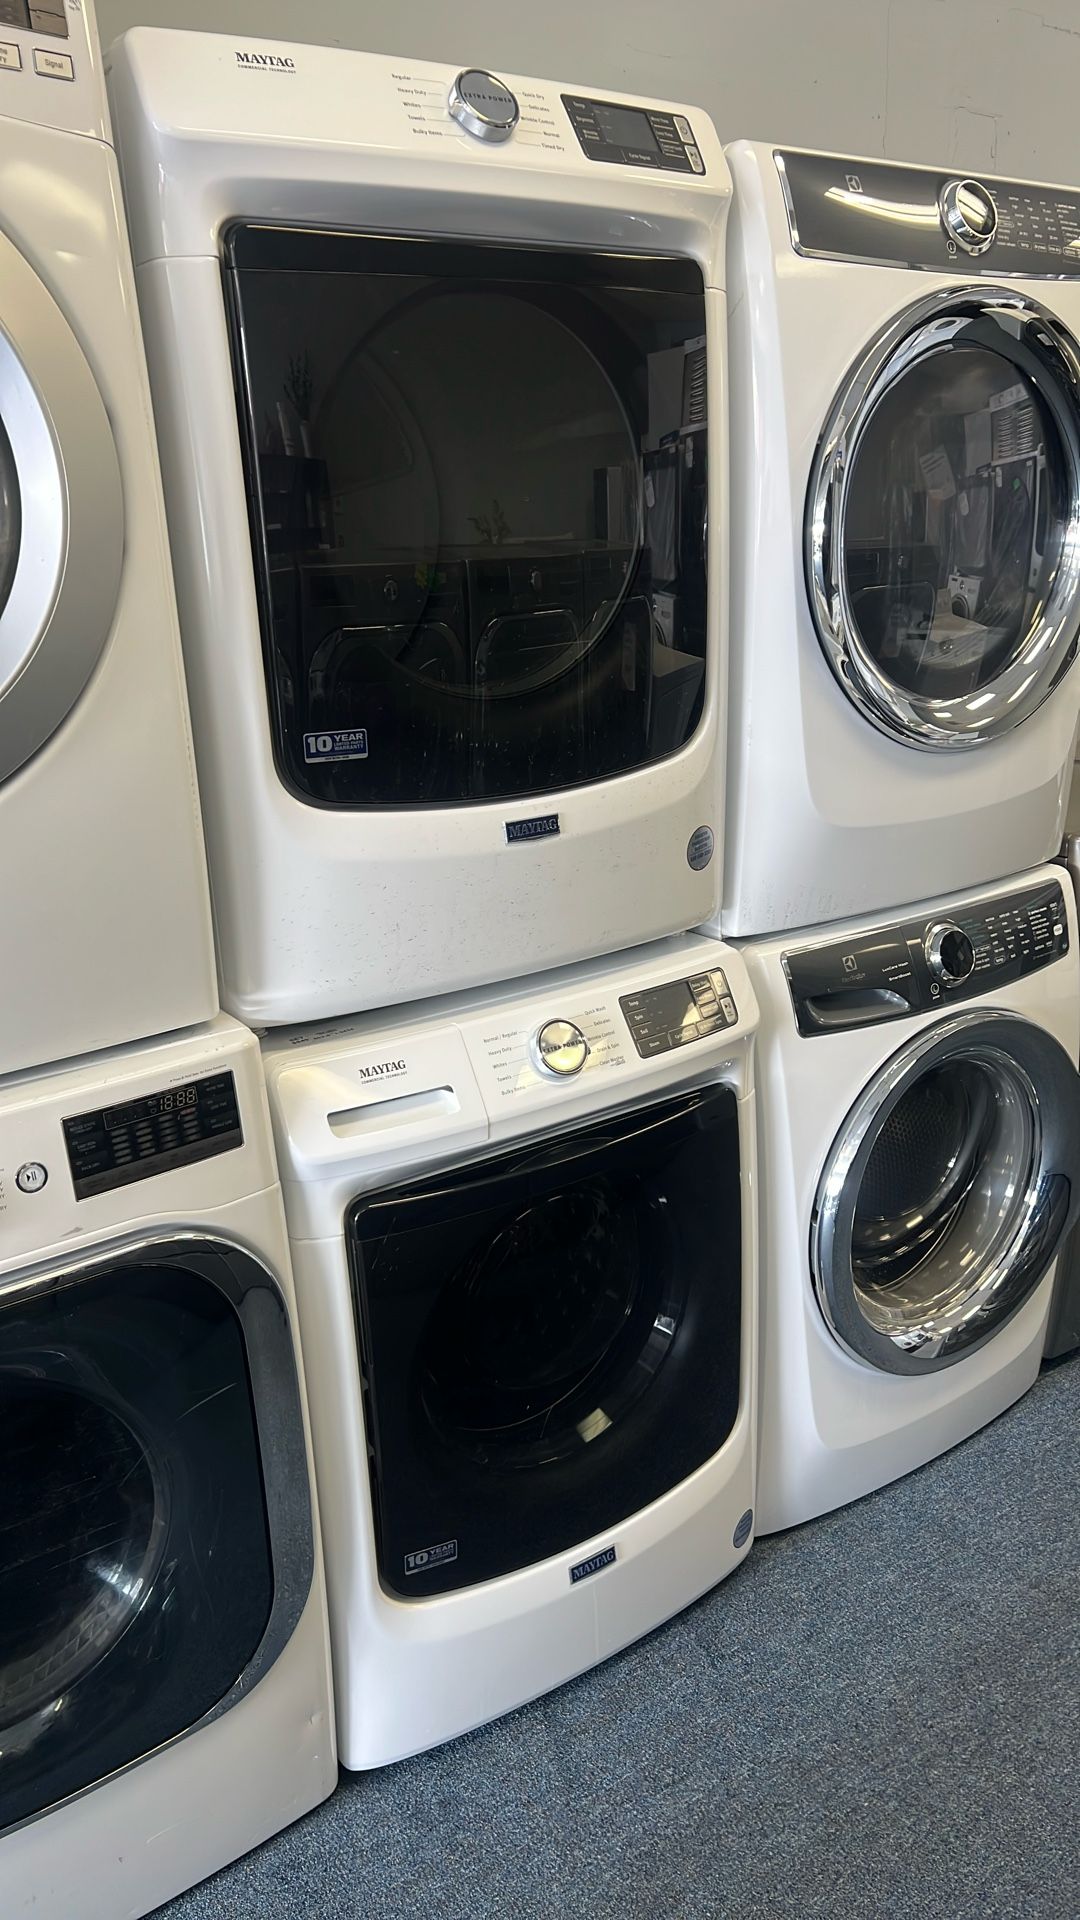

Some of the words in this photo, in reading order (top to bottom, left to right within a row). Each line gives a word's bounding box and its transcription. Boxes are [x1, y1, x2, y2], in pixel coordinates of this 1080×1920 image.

[45, 59, 63, 69] Signal
[235, 51, 295, 68] MAYTAG
[392, 73, 411, 81] Regular
[397, 87, 414, 95] Heavy
[308, 735, 332, 753] 10
[334, 733, 363, 742] YEAR
[508, 818, 557, 838] MAYTAG
[483, 1036, 499, 1044] Normal
[502, 1031, 517, 1039] Regular
[543, 1045, 562, 1053] EXTRA
[562, 1039, 585, 1048] POWER
[358, 1059, 406, 1079] MAYTAG
[501, 1088, 514, 1096] Bulky
[407, 1552, 429, 1567] 10
[430, 1543, 454, 1554] YEAR
[573, 1550, 614, 1579] MAYTAG
